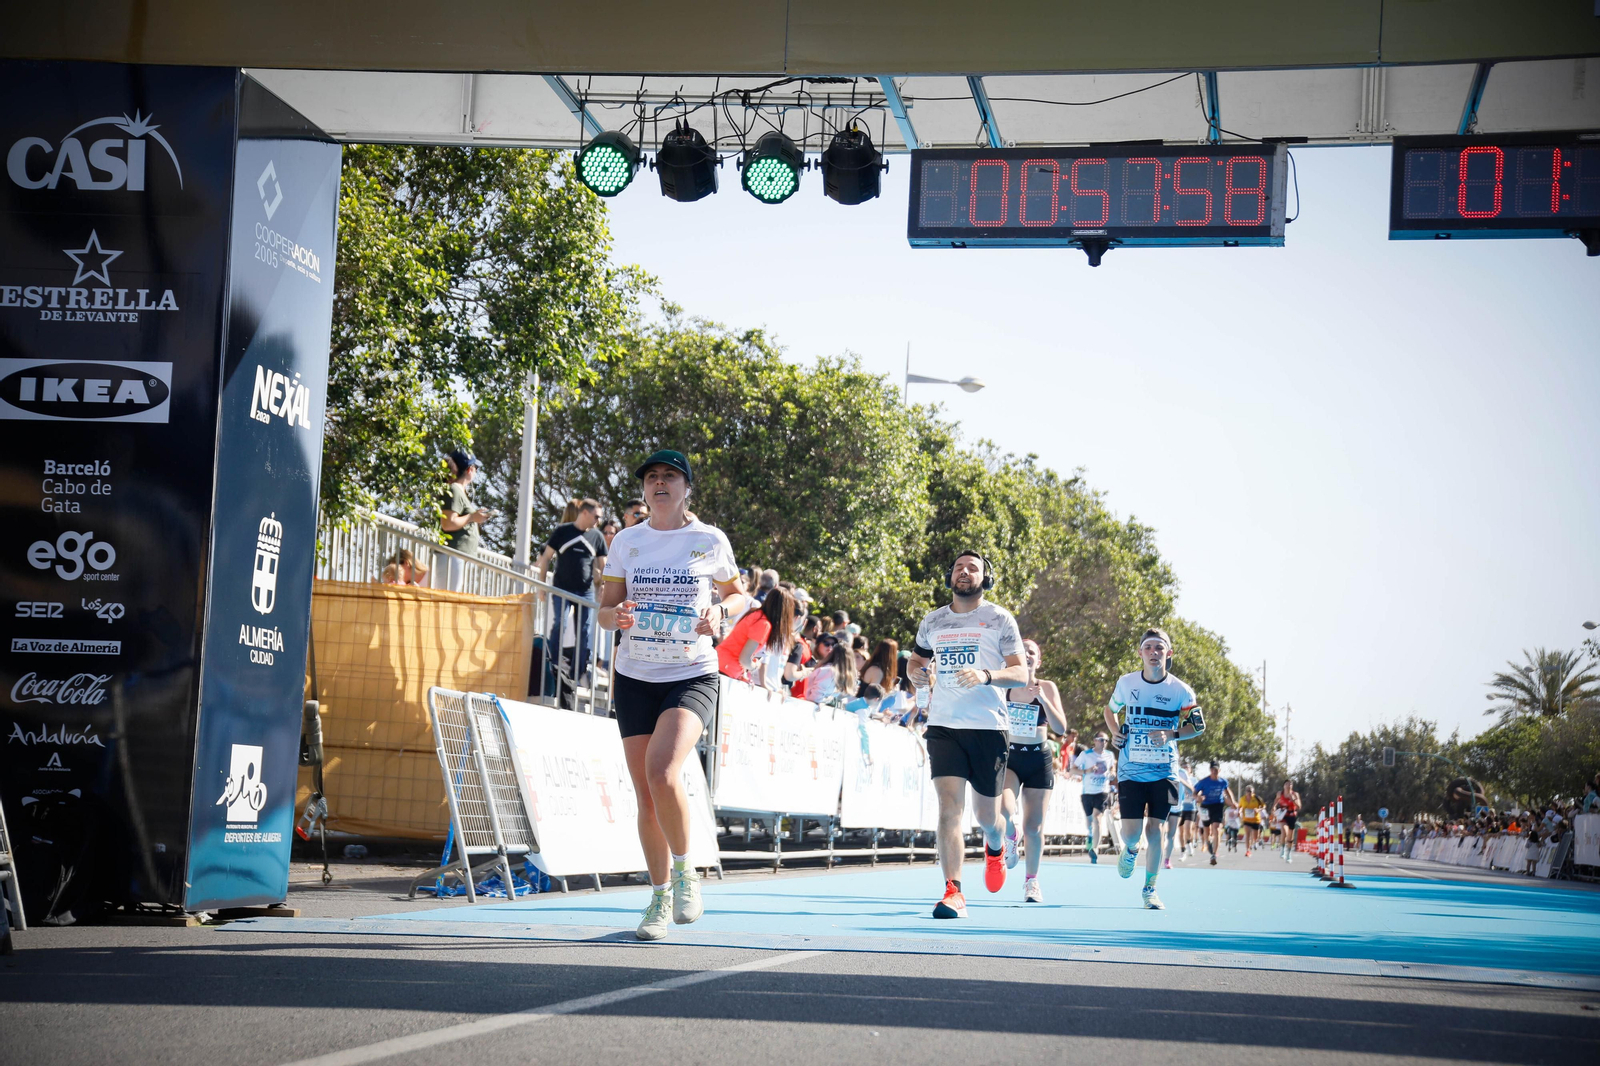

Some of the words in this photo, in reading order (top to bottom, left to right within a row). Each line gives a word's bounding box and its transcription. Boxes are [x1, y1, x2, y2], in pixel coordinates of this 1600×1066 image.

[7, 137, 146, 191] CASI
[254, 222, 320, 273] COOPERACIÓN
[254, 242, 279, 268] 2005
[0, 285, 179, 311] ESTRELLA
[40, 310, 63, 321] DE
[65, 311, 139, 323] LEVANTE
[19, 377, 151, 404] IKEA
[250, 364, 310, 430] NEXAL
[256, 410, 271, 425] 2020
[43, 459, 111, 476] Barceló
[42, 478, 86, 495] Cabo
[90, 479, 112, 495] de
[41, 497, 81, 513] Gata
[27, 531, 116, 581] ego
[82, 572, 100, 582] sport
[100, 573, 120, 581] center
[632, 574, 671, 584] Almería
[672, 575, 700, 585] 2024
[633, 567, 660, 575] Medio
[15, 601, 64, 618] SER
[96, 602, 125, 624] 40
[637, 612, 692, 634] 5078
[238, 623, 284, 653] ALMERÍA
[13, 641, 28, 651] La
[30, 641, 52, 652] Voz
[54, 642, 69, 652] de
[70, 643, 119, 653] Almería
[250, 649, 274, 666] CIUDAD
[940, 652, 976, 666] 5500
[10, 672, 114, 705] Coca-Cola
[1127, 716, 1173, 727] LCAUDET
[7, 721, 106, 748] Andalucía
[1134, 734, 1155, 746] 51
[254, 833, 262, 843] DE
